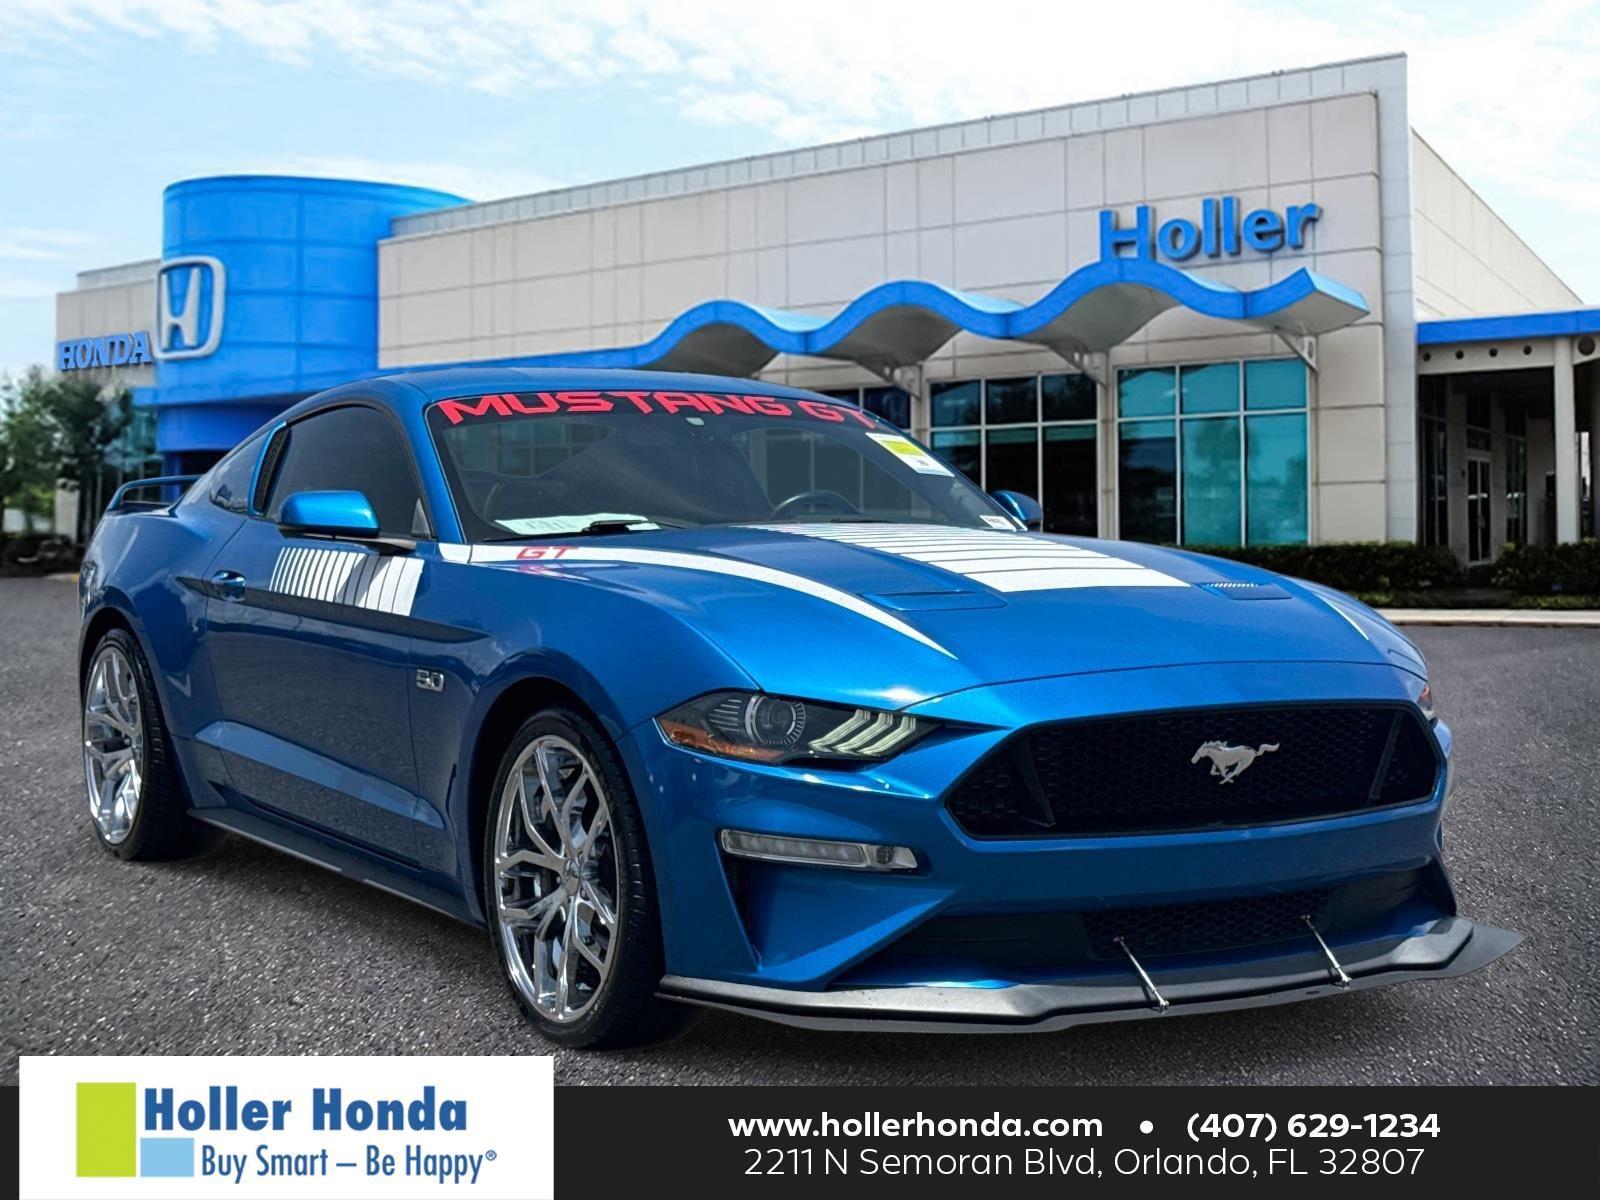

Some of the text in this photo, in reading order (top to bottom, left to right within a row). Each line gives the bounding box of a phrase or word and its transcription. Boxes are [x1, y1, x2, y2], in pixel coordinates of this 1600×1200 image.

[1099, 196, 1322, 263] Holler
[57, 330, 152, 372] HONDA
[436, 391, 876, 430] MUSTANG GT
[516, 545, 580, 560] GT
